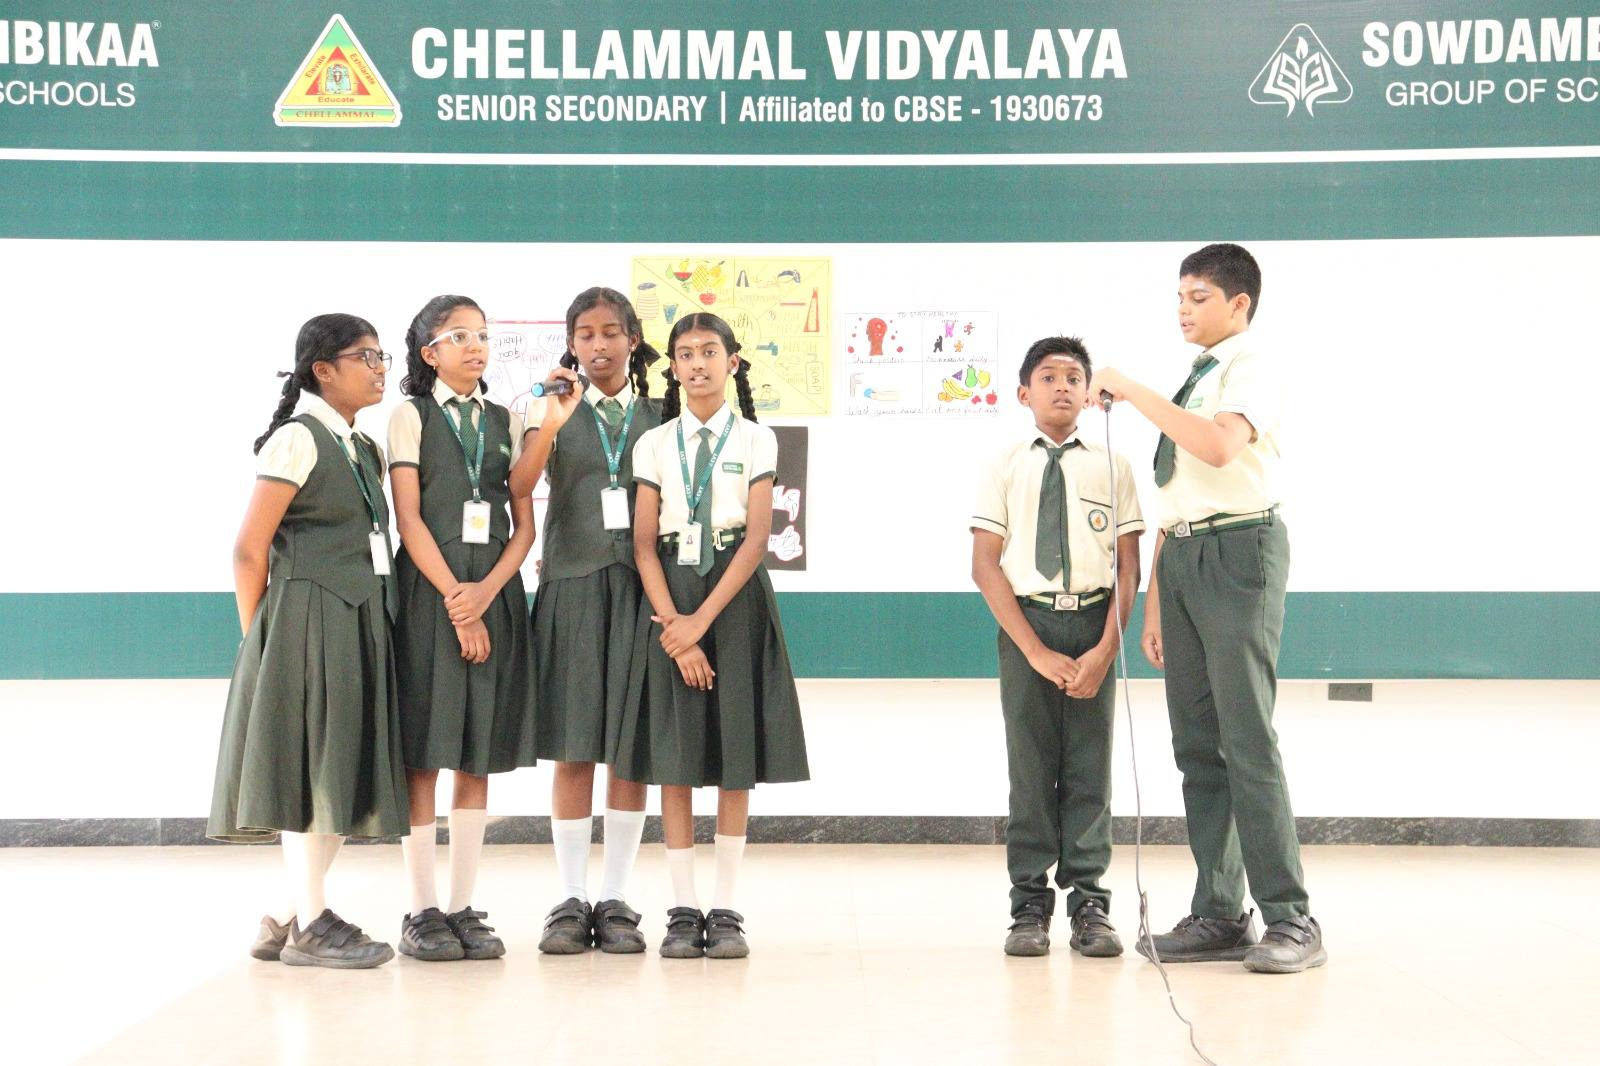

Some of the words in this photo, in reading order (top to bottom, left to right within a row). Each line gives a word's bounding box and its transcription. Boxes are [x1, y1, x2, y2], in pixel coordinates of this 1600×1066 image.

[304, 54, 327, 79] Elevate
[411, 27, 807, 80] CHELLAMMAL
[825, 28, 1128, 80] VIDYALAYA
[349, 53, 376, 85] Exhilarate
[1385, 80, 1496, 107] GROUP
[1504, 78, 1547, 105] OF
[437, 94, 537, 122] SENIOR
[545, 94, 707, 122] SECONDARY
[739, 95, 852, 122] Affiliated
[860, 97, 885, 122] to
[894, 95, 962, 122] CBSE
[990, 95, 1103, 122] 1930673
